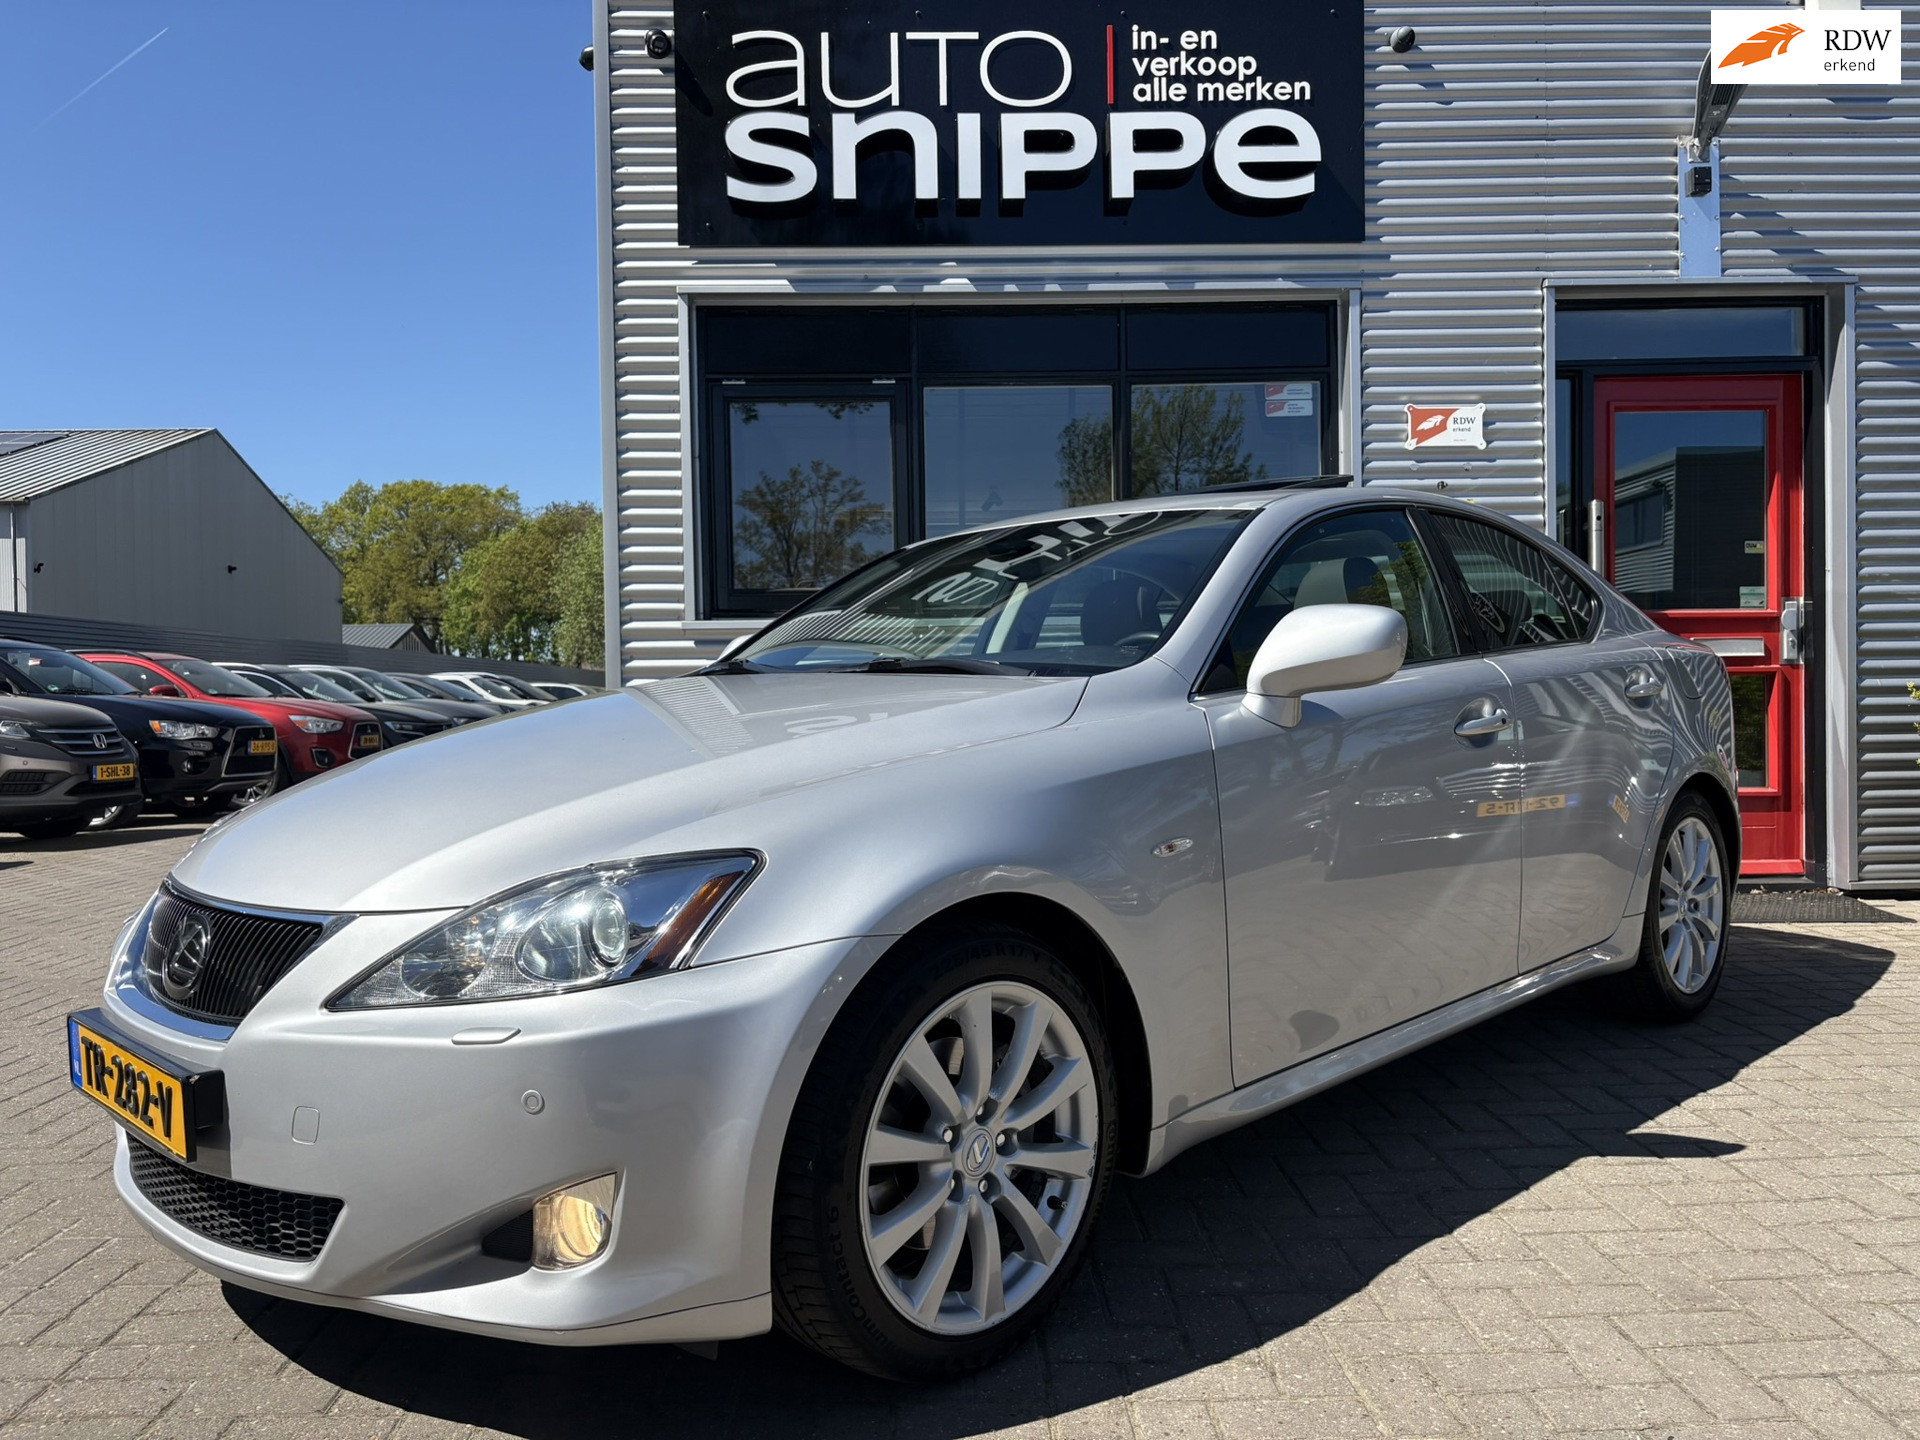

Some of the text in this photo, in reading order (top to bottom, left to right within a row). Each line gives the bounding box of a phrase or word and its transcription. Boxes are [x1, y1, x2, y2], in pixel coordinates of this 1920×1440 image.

[1131, 24, 1218, 50] in- en
[1131, 50, 1258, 82] verkoop
[1132, 75, 1312, 102] alle merken
[1452, 416, 1477, 425] RDW
[100, 764, 131, 779] 1-SHL-38
[80, 1035, 173, 1141] TR-282-V
